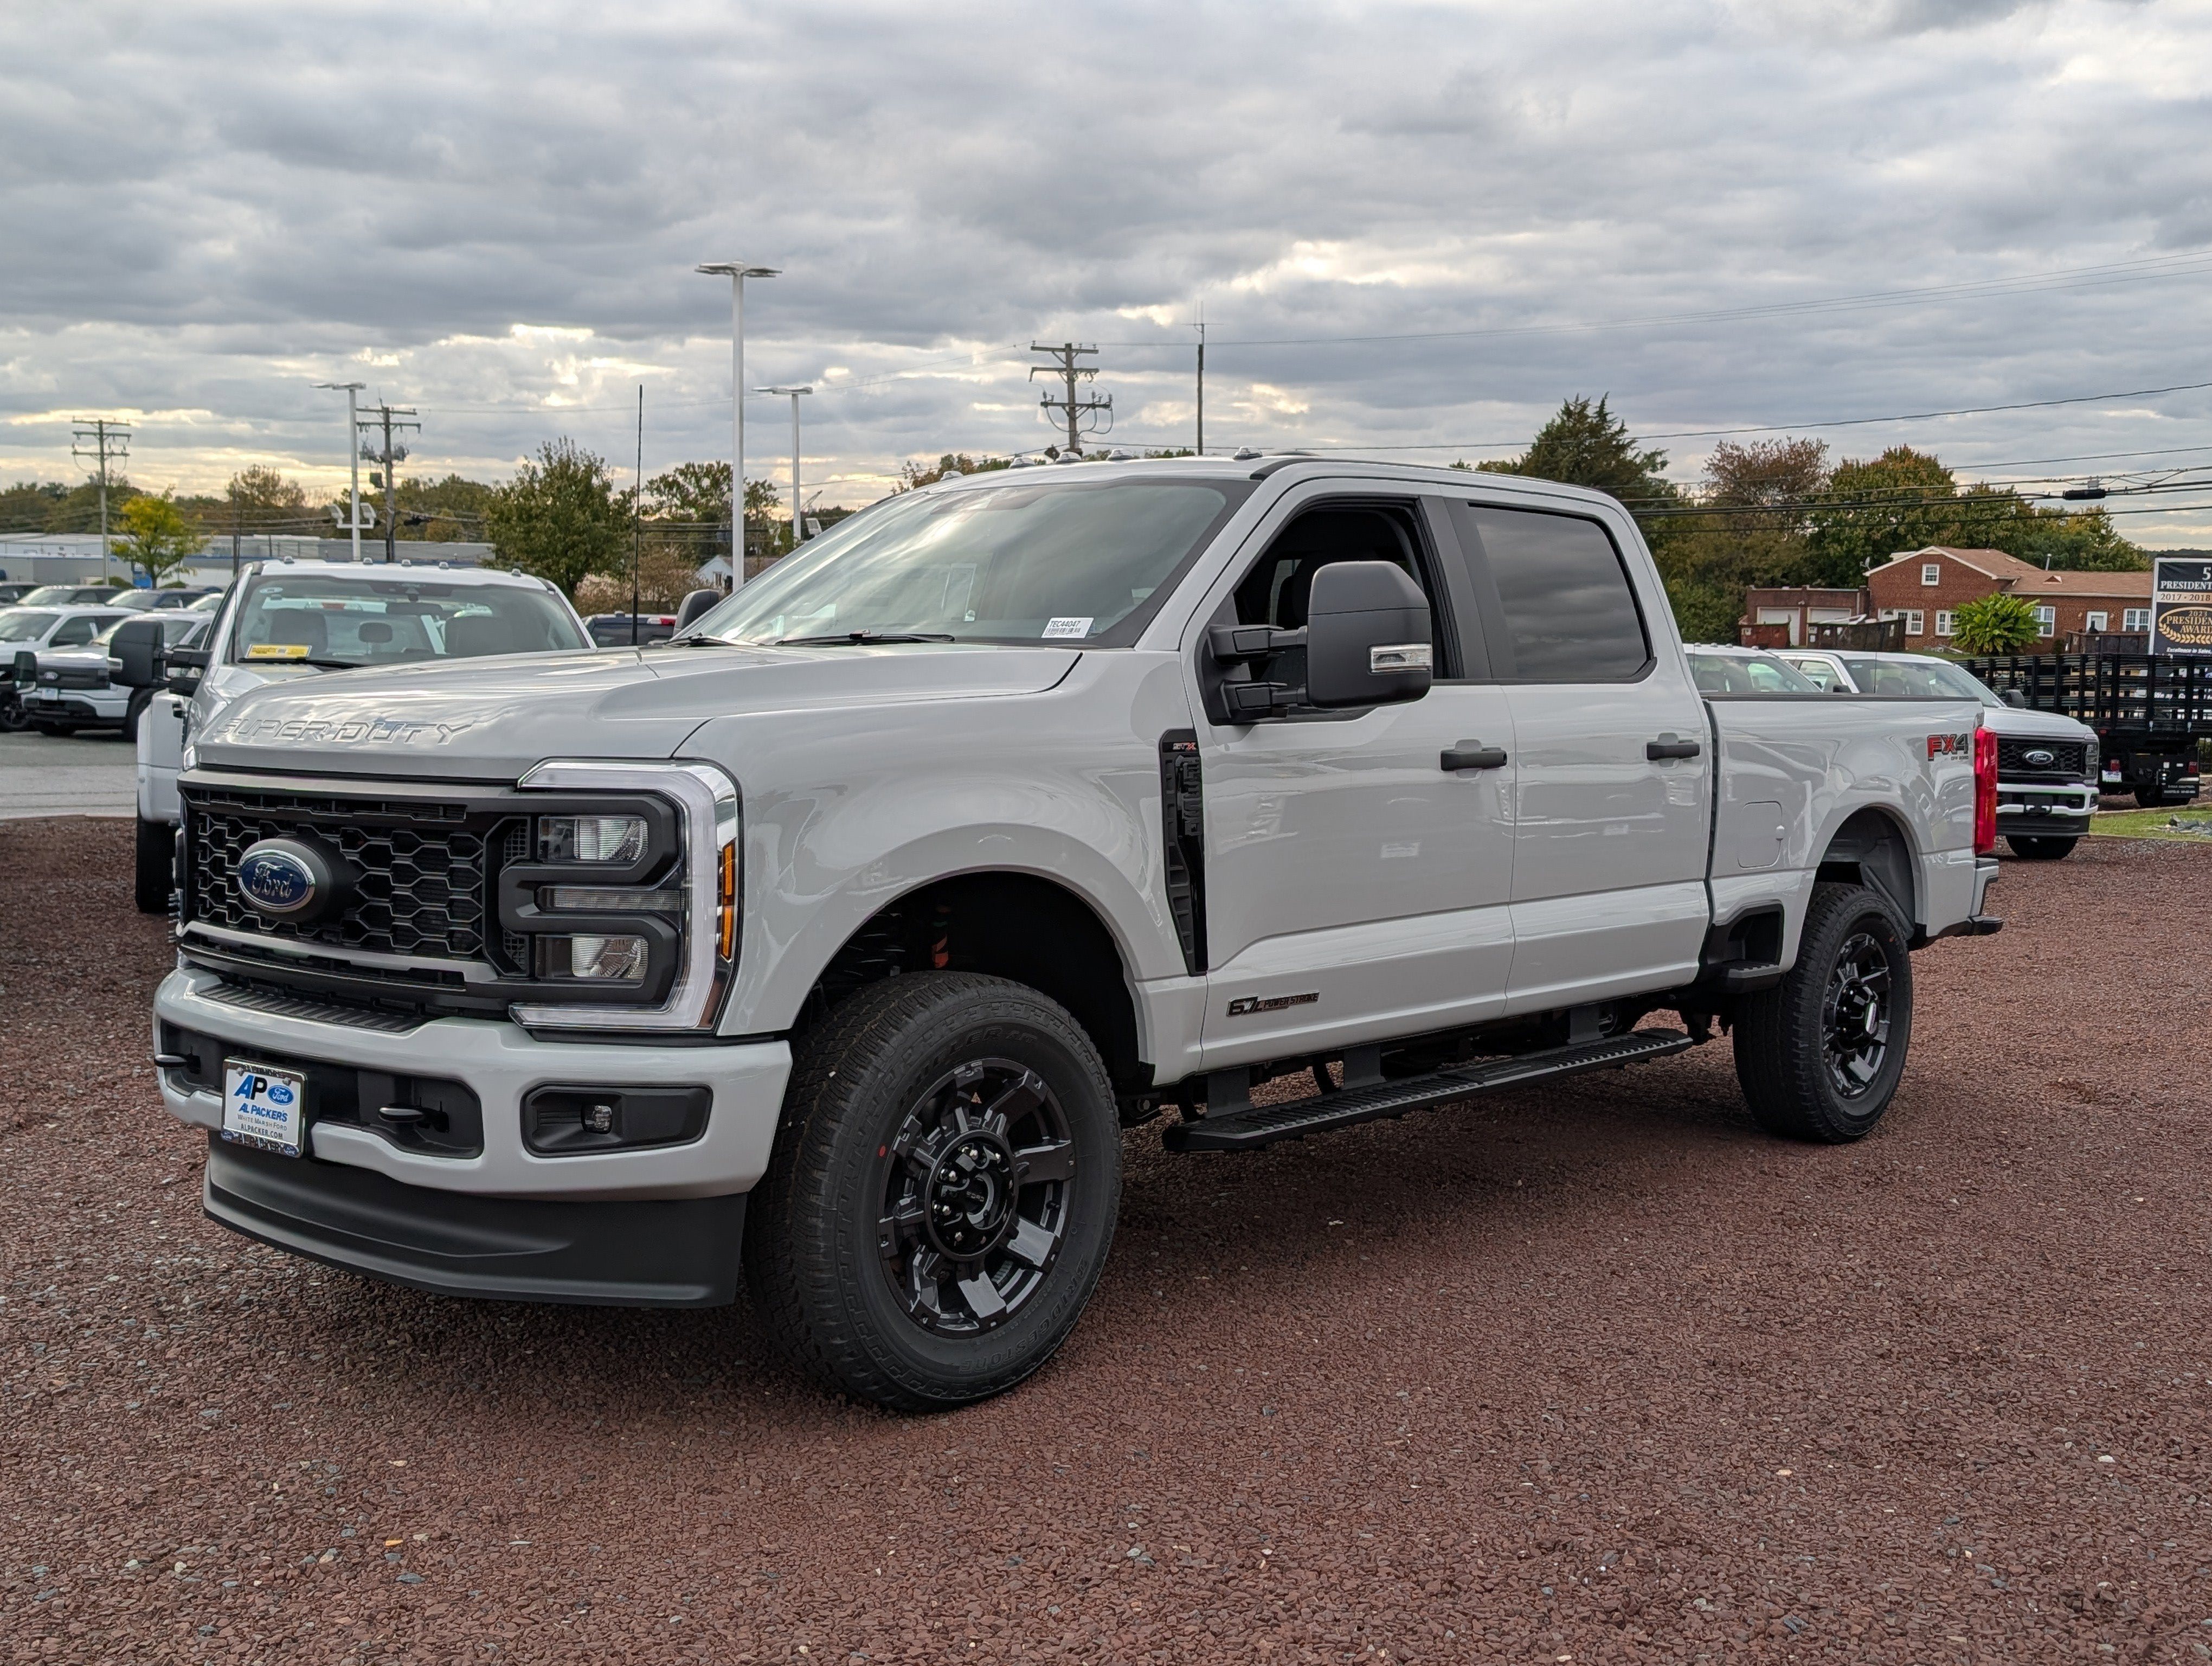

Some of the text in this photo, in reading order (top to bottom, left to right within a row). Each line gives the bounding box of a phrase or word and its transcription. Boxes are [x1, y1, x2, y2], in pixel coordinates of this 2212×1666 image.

[2160, 580, 2212, 590] PRESIDENT
[217, 718, 472, 746] SUPER DUTY
[1926, 733, 1969, 761] FX4
[252, 861, 293, 898] Ford
[1264, 997, 1289, 1008] POWER
[1290, 994, 1319, 1004] STROKE
[234, 1074, 289, 1102] AP Ford
[239, 1103, 288, 1123] AL PACKER'S
[240, 1123, 283, 1139] ALPACKER.COM
[959, 1254, 1089, 1373] BRIDGESTONE
